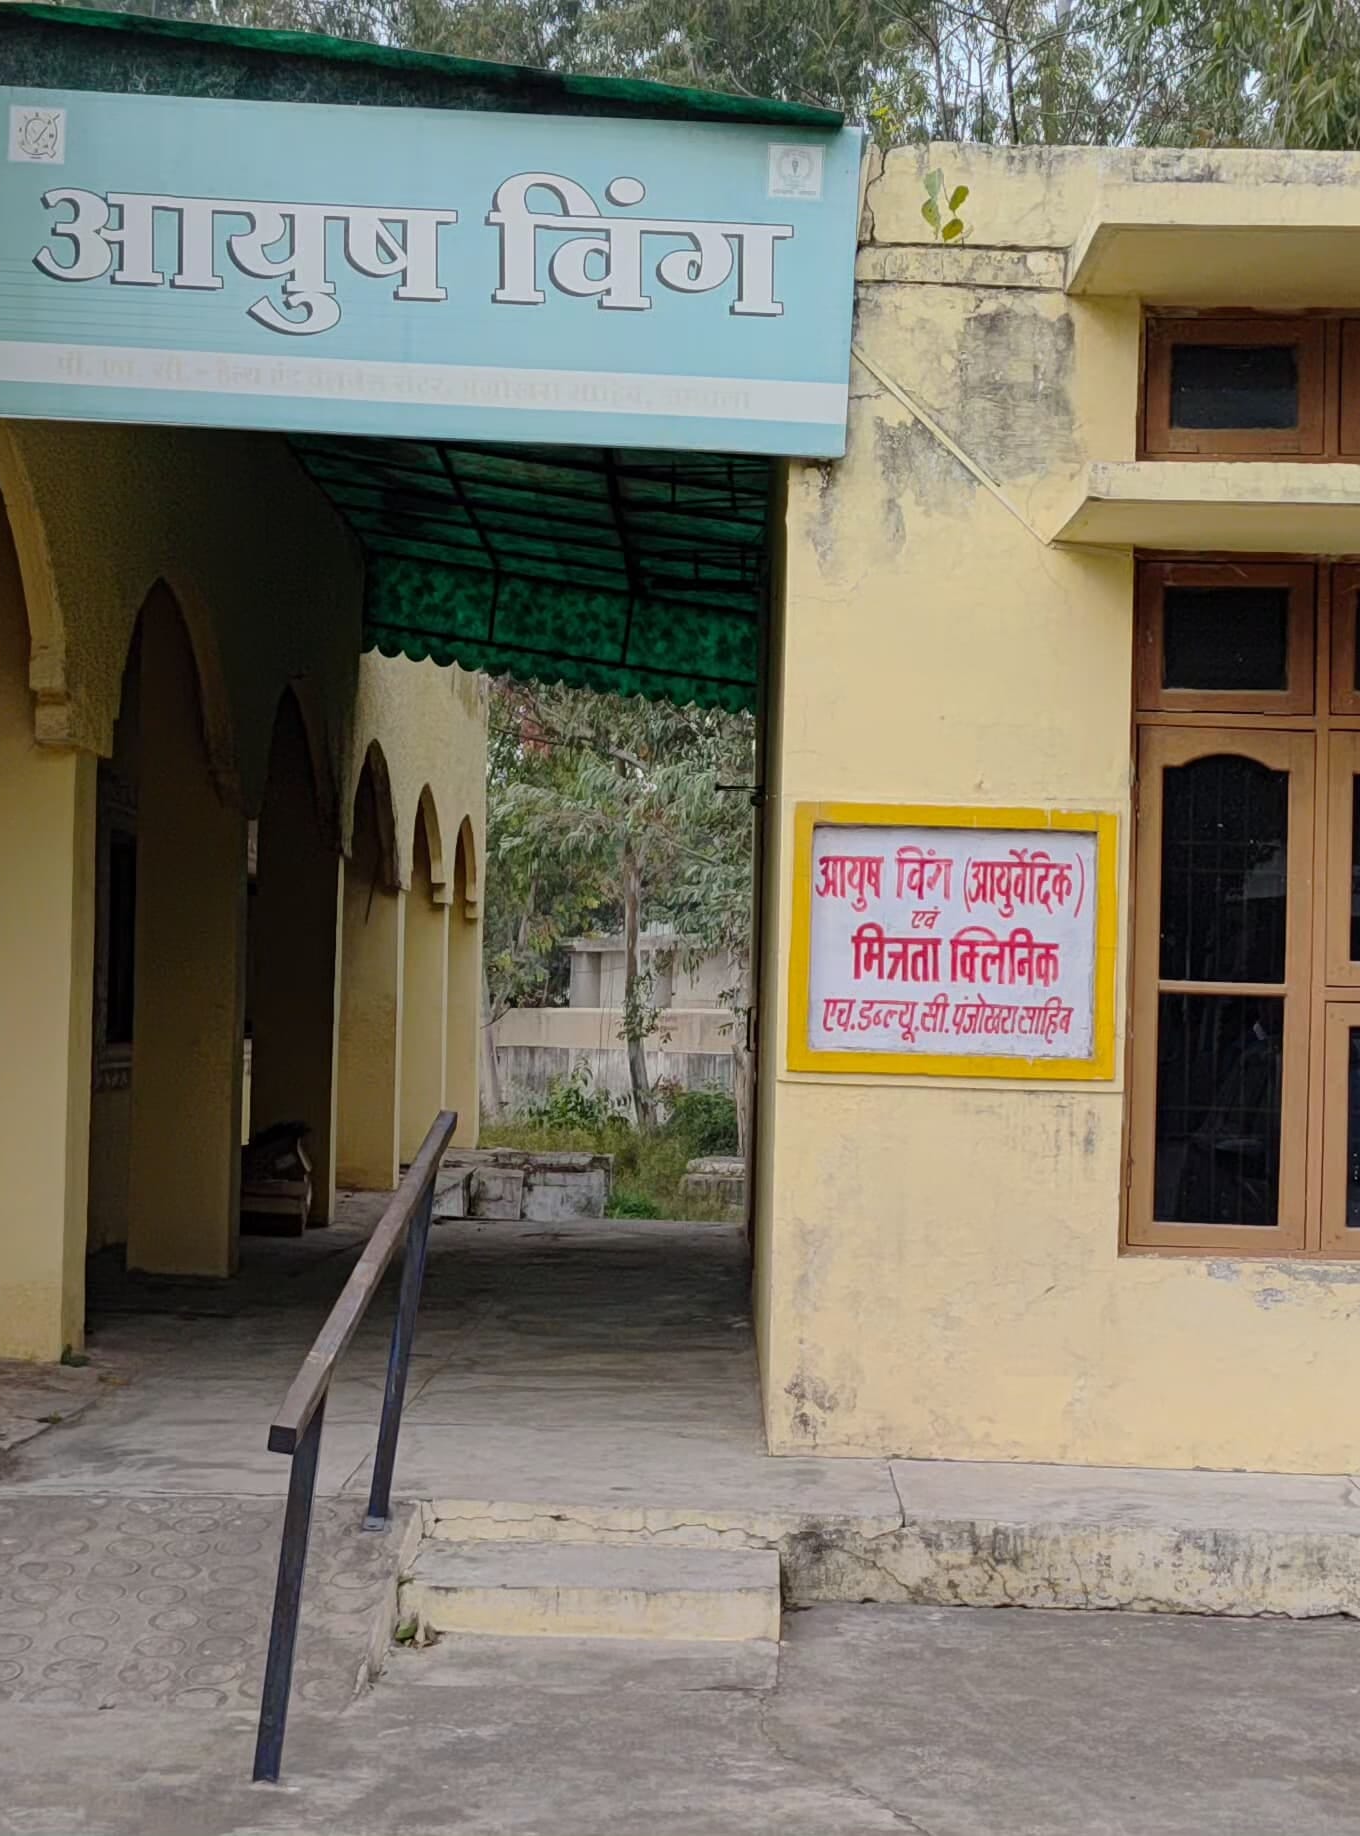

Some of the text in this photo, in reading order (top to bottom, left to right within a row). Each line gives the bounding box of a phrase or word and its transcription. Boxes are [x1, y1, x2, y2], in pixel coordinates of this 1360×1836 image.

[33, 171, 794, 336] आयुष विंग
[815, 845, 1085, 919] आयुष विंग (आयुर्वेदिक)
[911, 905, 942, 930] एवं
[851, 921, 1060, 988] मित्रता क्लिनिक
